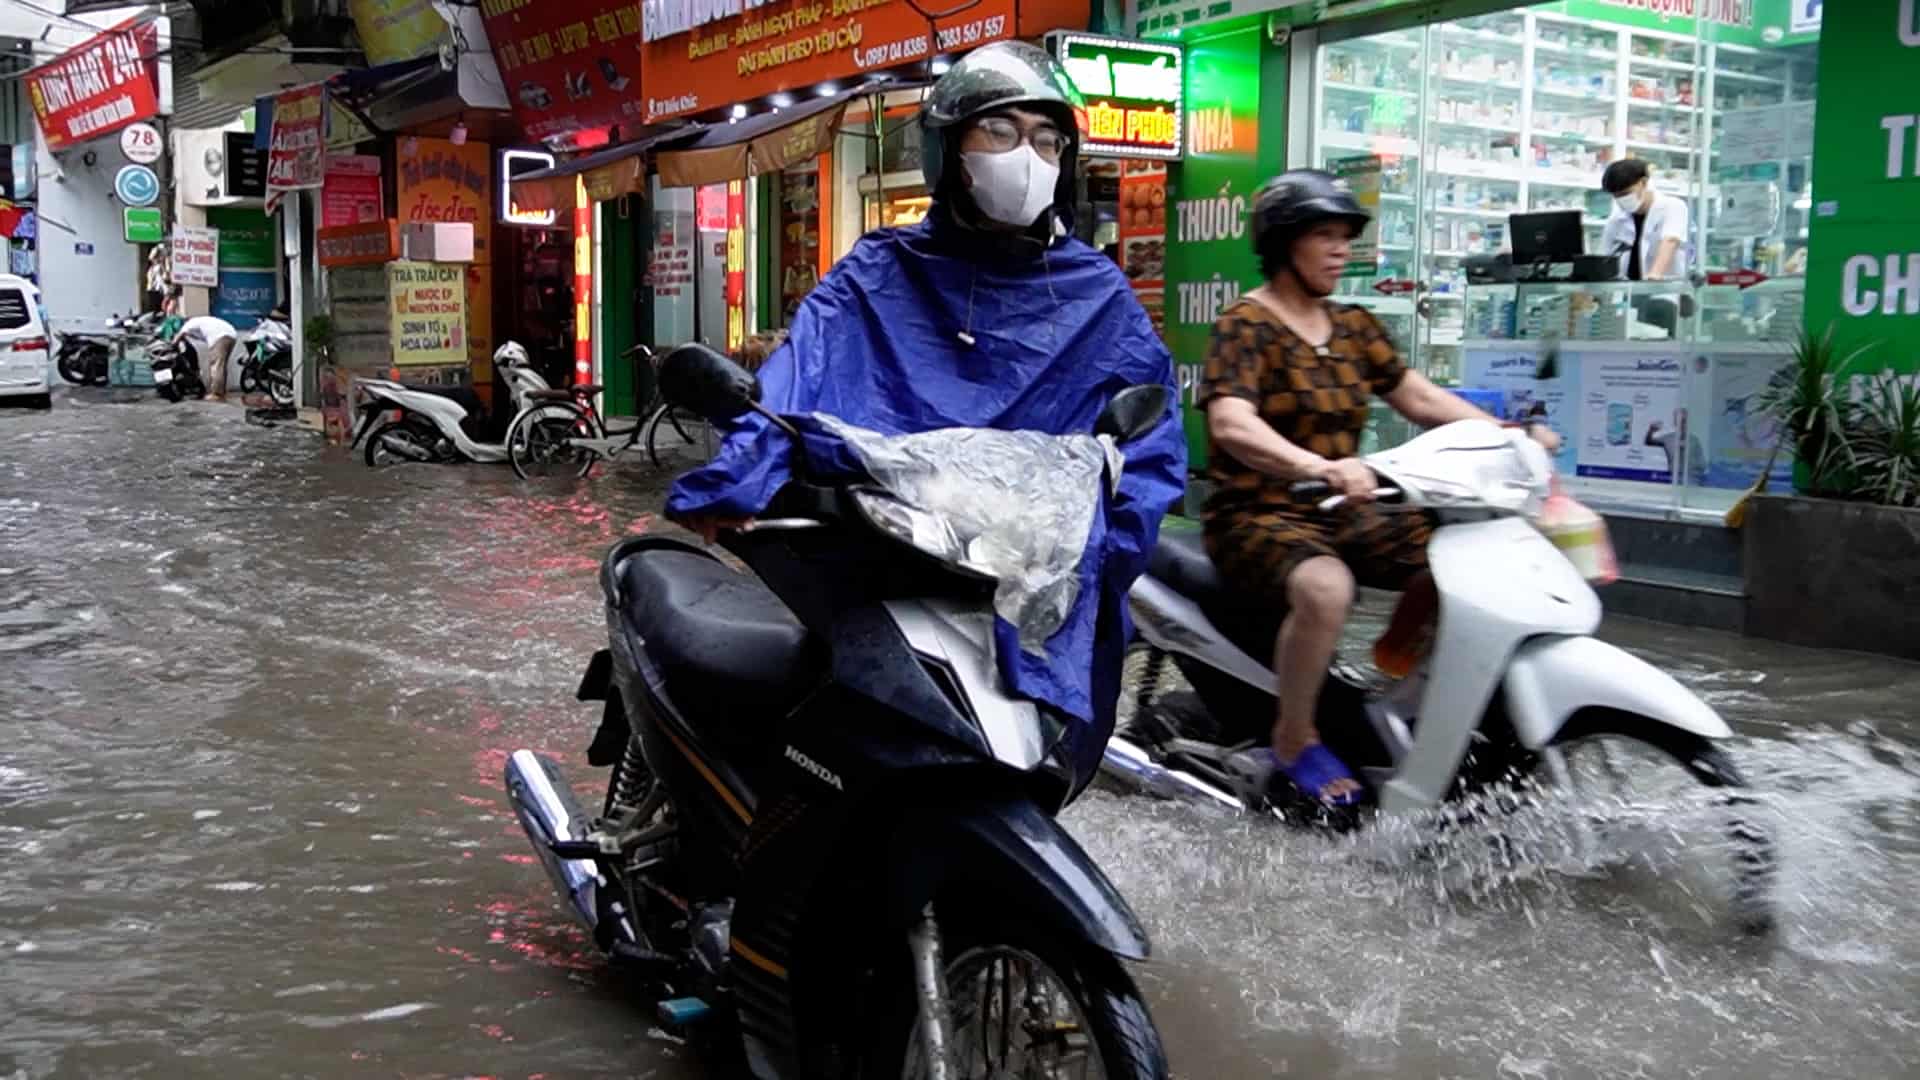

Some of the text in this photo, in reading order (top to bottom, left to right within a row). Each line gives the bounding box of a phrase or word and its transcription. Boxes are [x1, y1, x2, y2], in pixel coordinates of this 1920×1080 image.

[985, 14, 1006, 38] 557
[1176, 177, 1246, 243] THUỐC
[784, 744, 844, 792] HONDA
